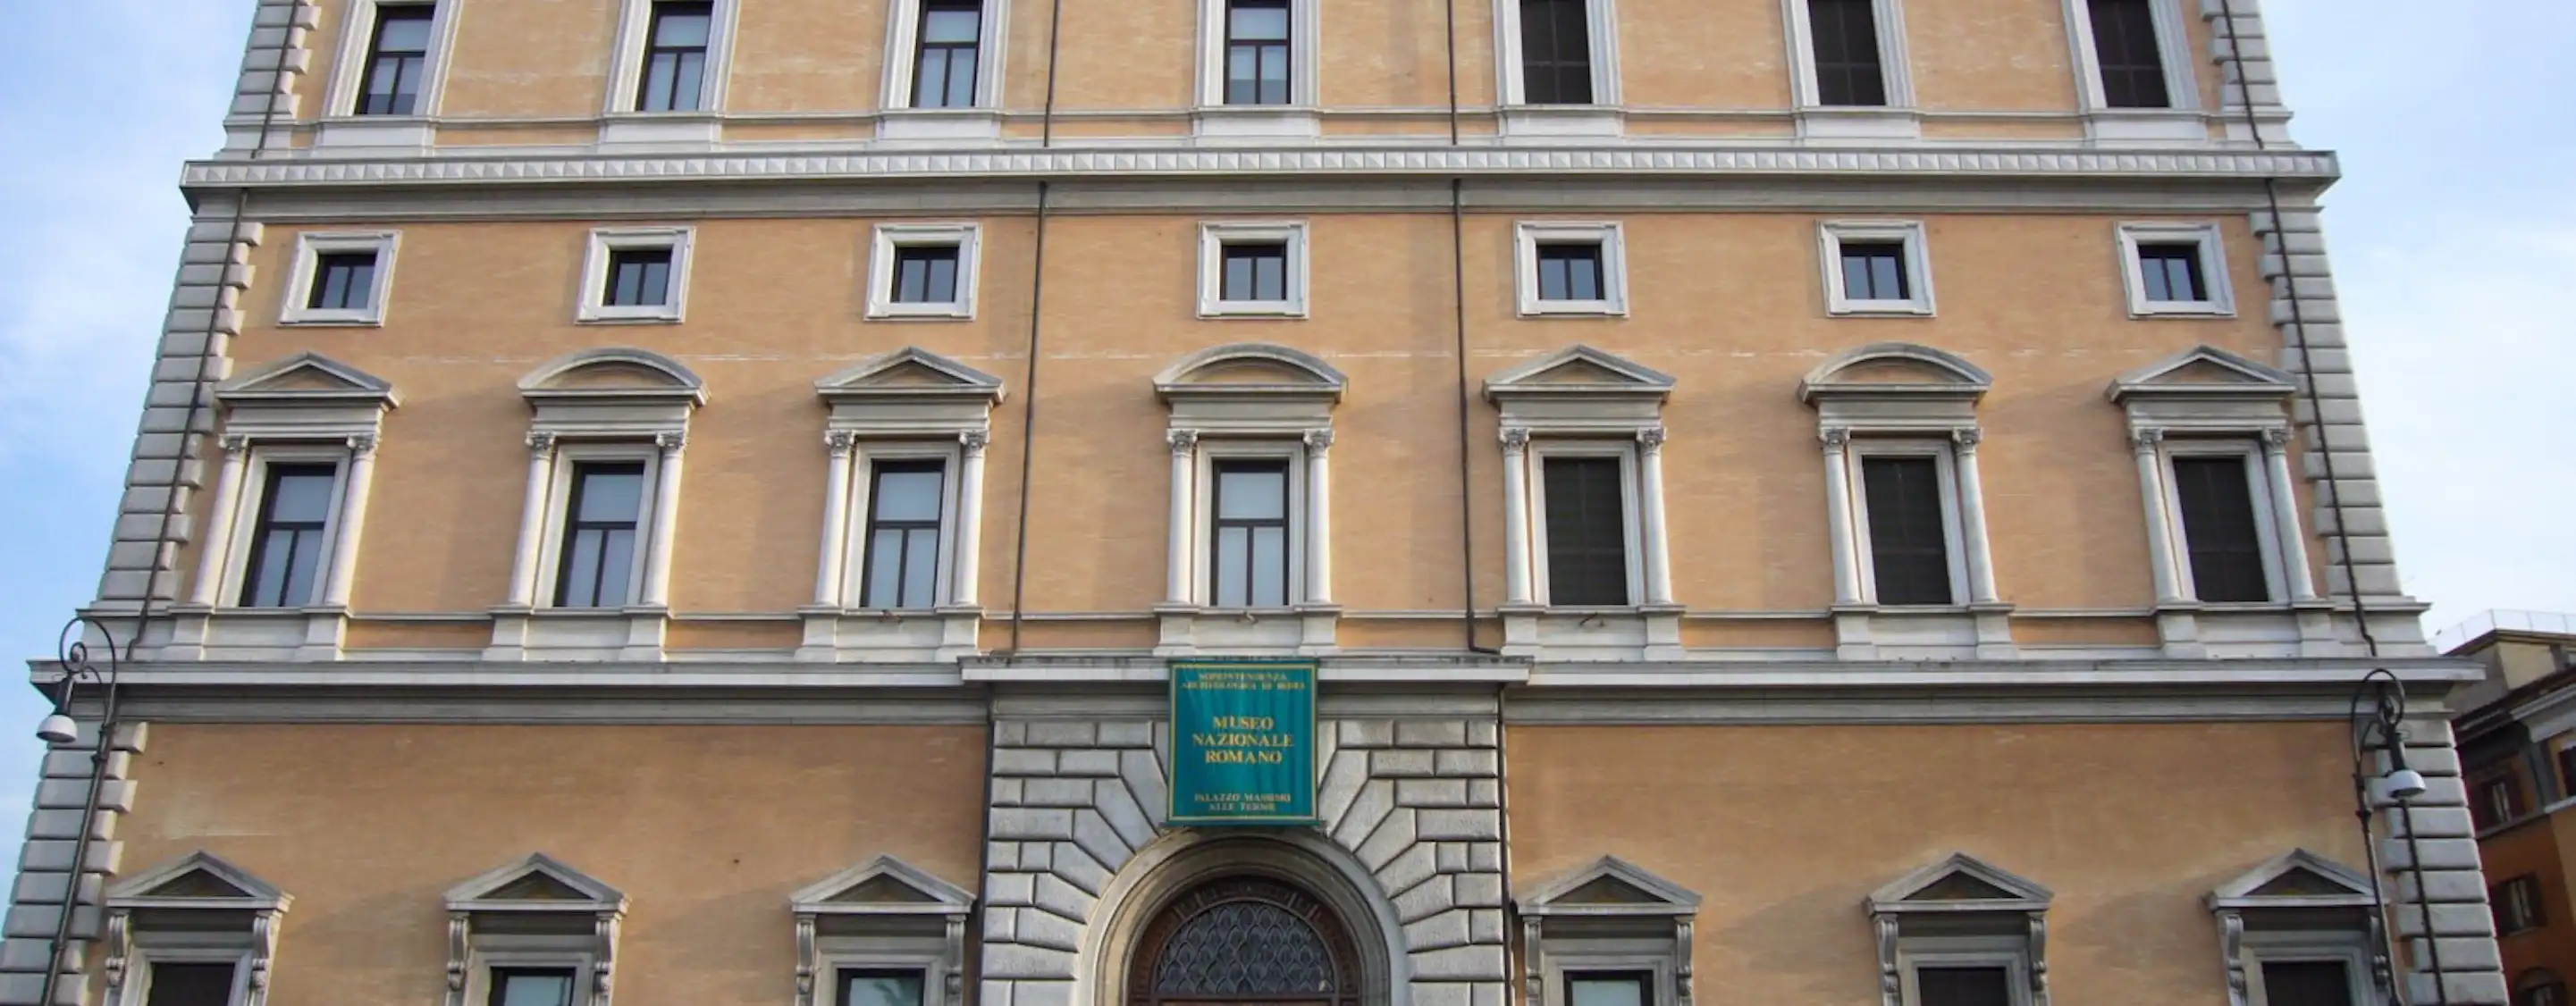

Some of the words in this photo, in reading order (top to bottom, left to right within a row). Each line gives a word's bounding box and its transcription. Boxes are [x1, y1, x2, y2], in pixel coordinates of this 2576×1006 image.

[1213, 717, 1275, 730] MUSEO
[1192, 734, 1294, 747] NAZIONALE
[1205, 750, 1283, 764] ROMANO
